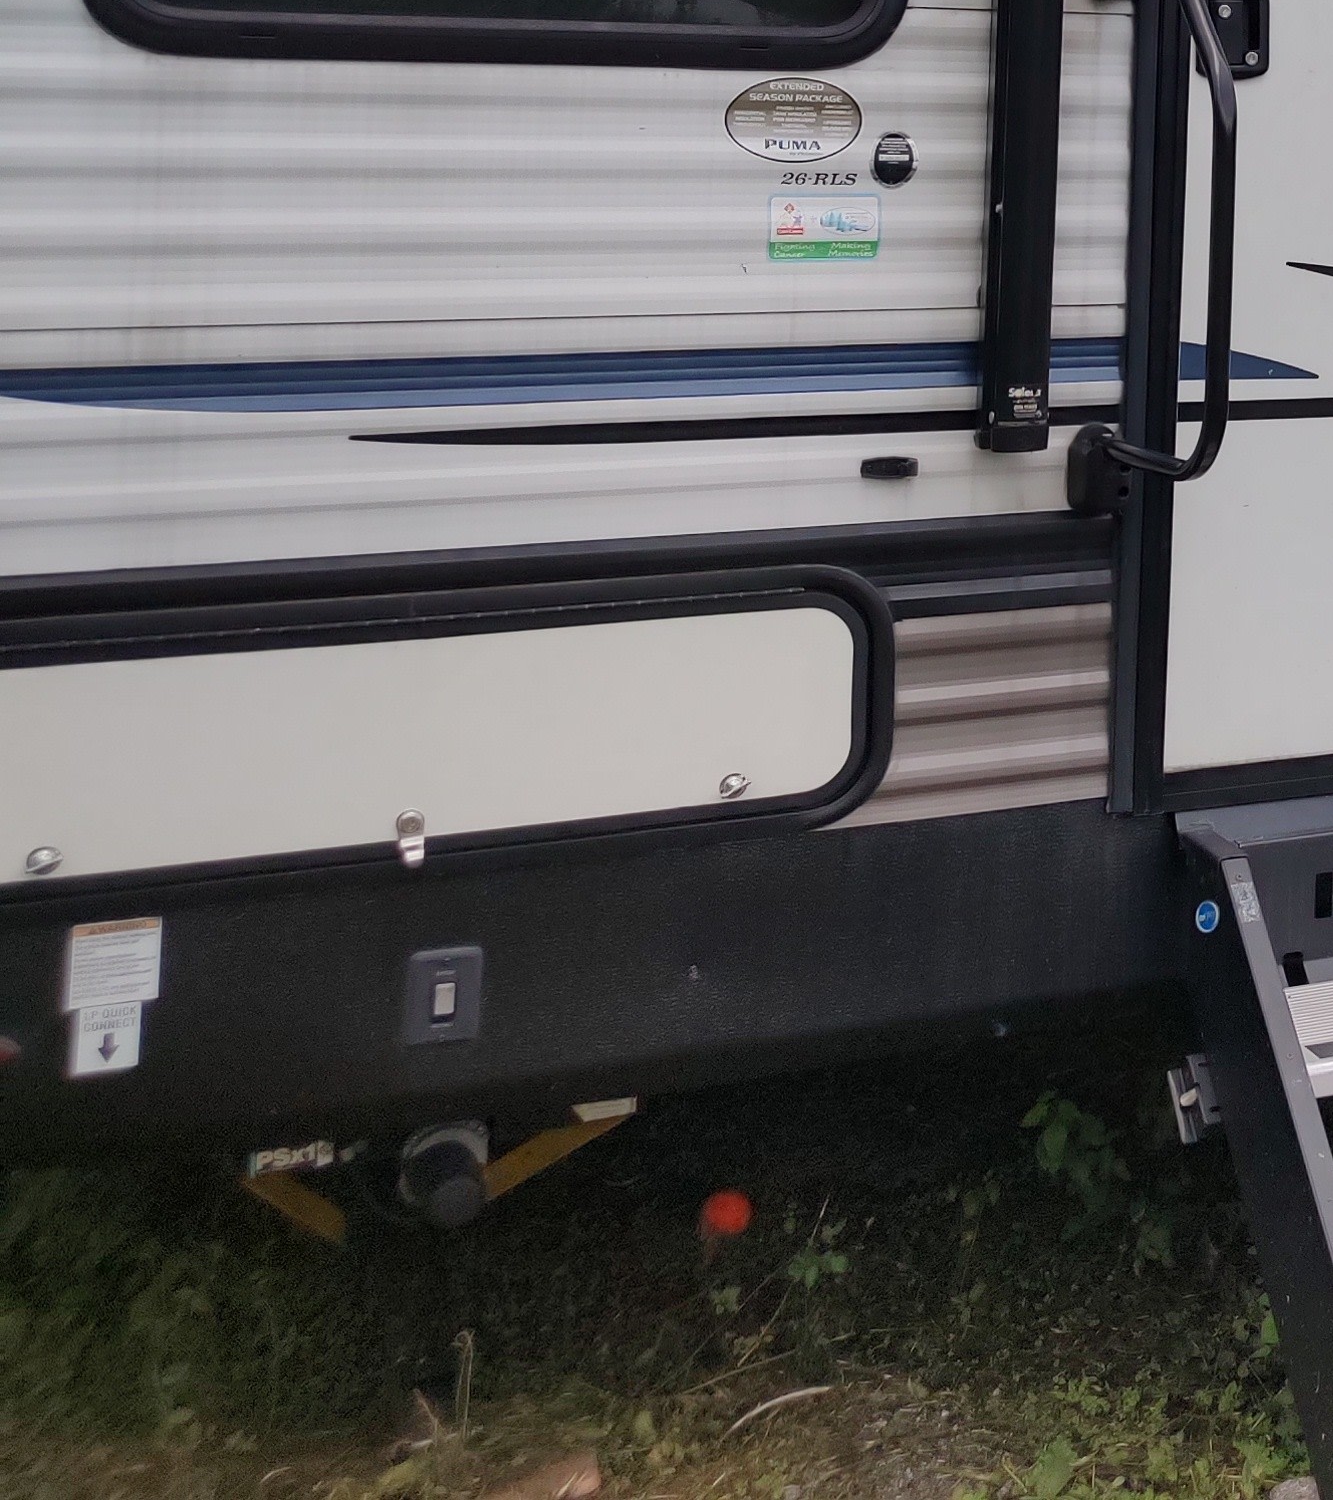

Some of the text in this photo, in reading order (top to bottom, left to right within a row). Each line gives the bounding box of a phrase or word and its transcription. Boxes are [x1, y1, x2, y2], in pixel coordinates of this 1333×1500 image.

[769, 81, 825, 91] EXTENDED
[749, 92, 843, 103] SEASON PACKAGE
[764, 138, 821, 151] PUMA
[780, 172, 858, 186] 26-RLS
[831, 242, 872, 251] Making
[773, 250, 874, 258] Cancer Memories
[102, 1005, 137, 1019] QUICK
[83, 1016, 137, 1033] CONNECT
